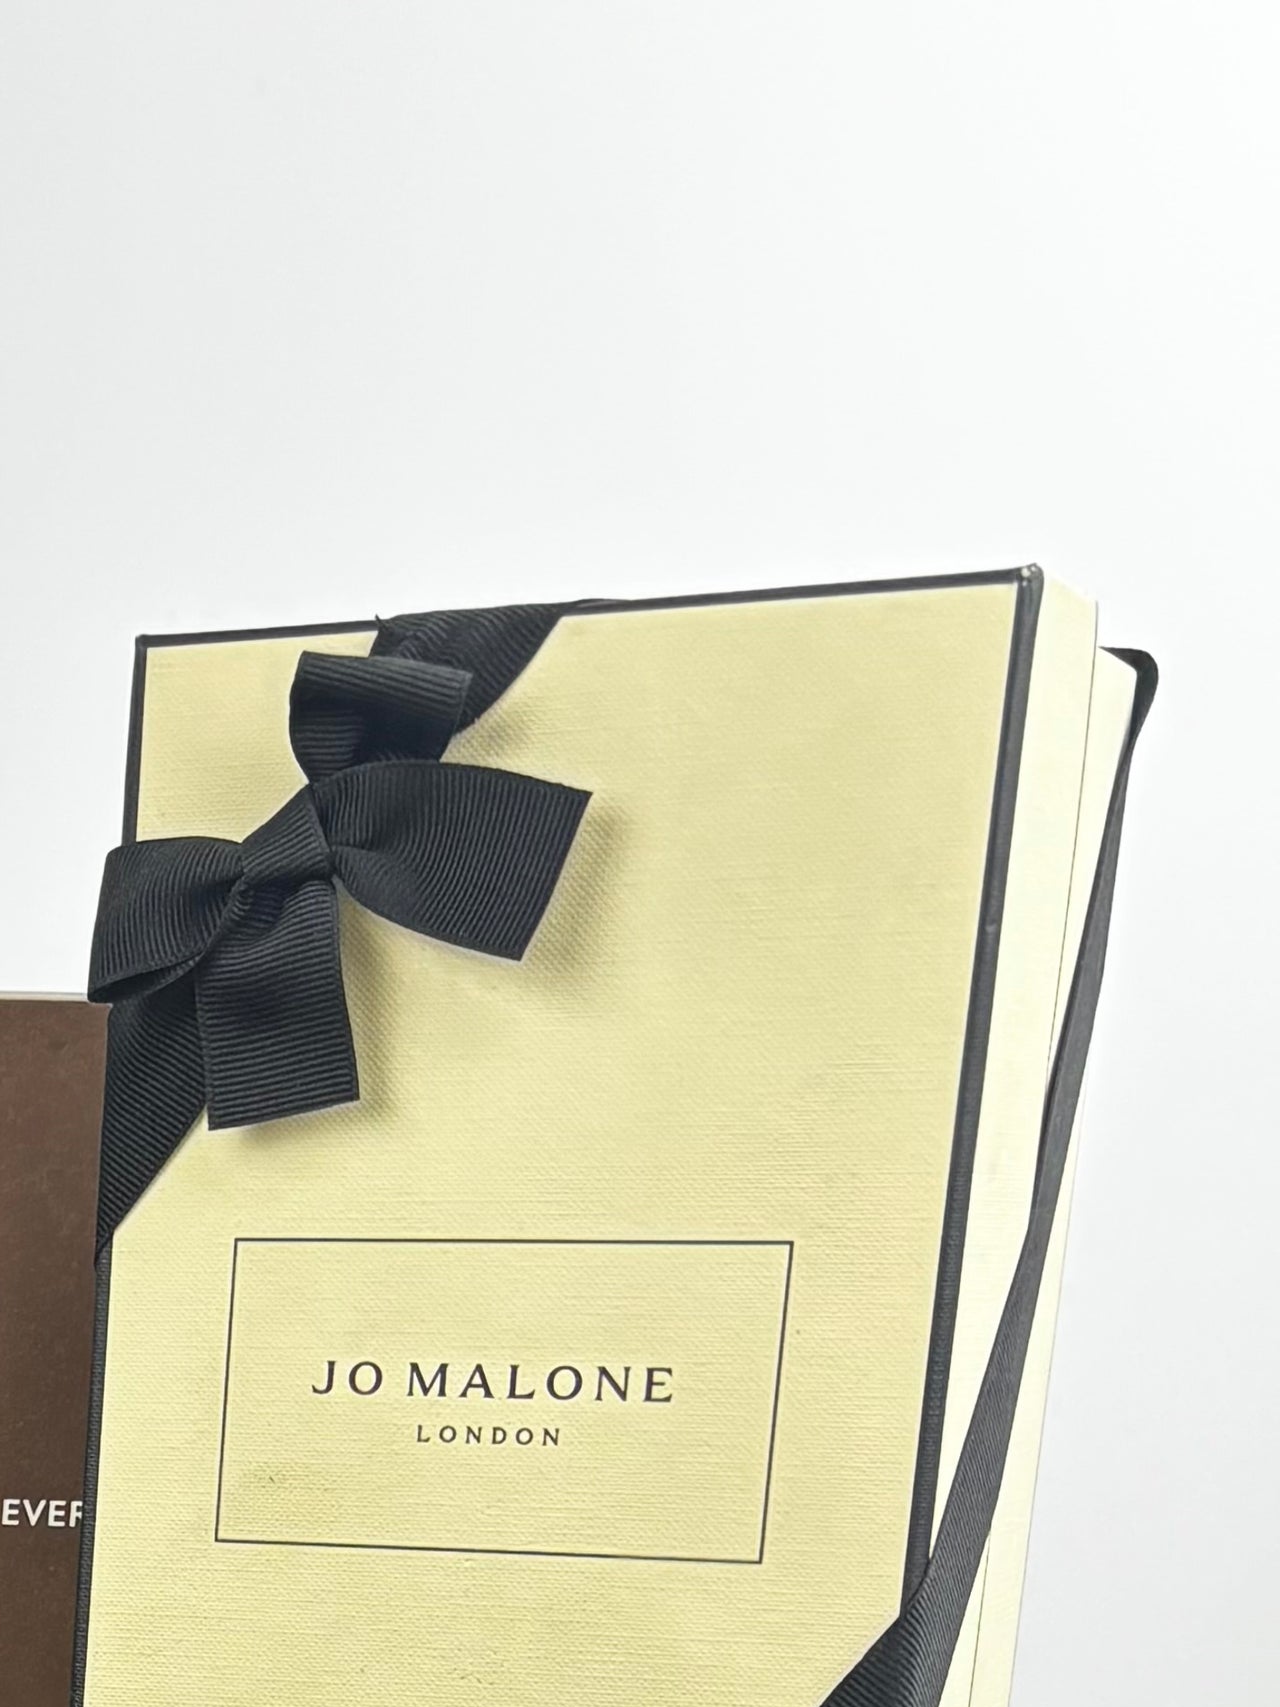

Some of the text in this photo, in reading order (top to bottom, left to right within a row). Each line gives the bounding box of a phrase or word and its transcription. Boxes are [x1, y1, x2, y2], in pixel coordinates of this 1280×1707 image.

[311, 1360, 674, 1403] JO MALONE
[416, 1424, 560, 1446] LONDON
